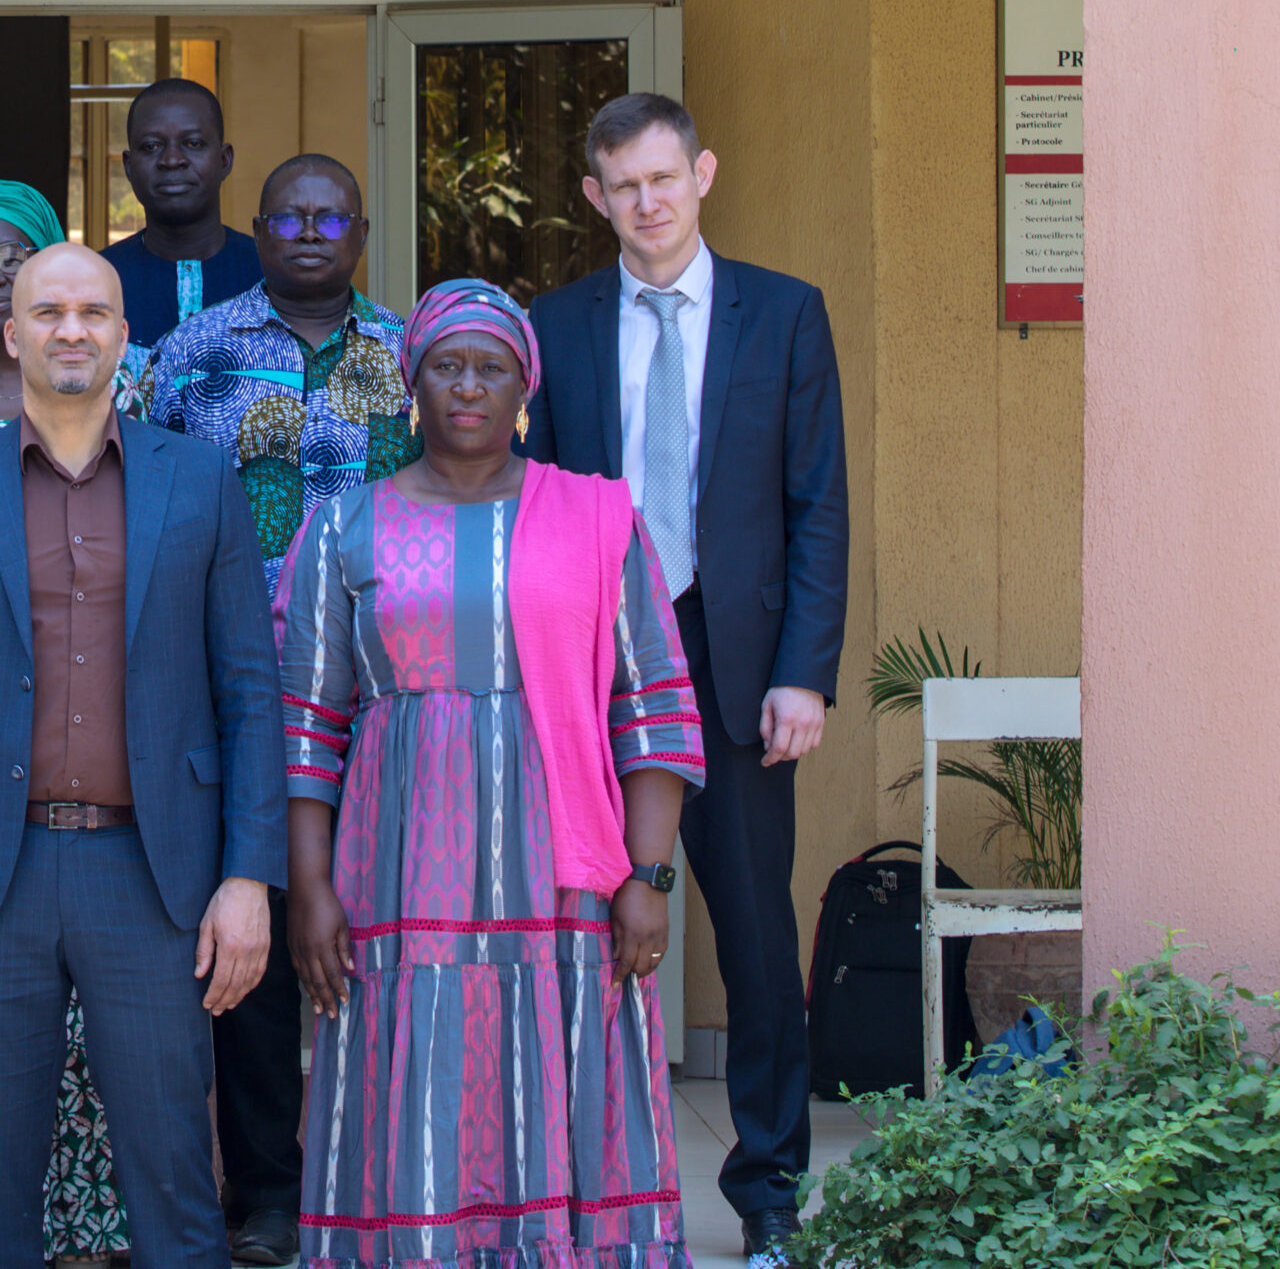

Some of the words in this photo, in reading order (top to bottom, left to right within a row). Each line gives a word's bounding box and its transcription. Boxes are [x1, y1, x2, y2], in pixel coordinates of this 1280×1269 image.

[1020, 111, 1068, 119] Secrétariat
[1015, 120, 1063, 130] particulier
[1021, 137, 1063, 146] Protocole
[1024, 180, 1069, 189] Secrétaire
[1025, 198, 1038, 206] SG
[1040, 198, 1072, 207] Adjoint
[1025, 215, 1073, 223] Secrétariat
[1025, 232, 1074, 240] Conseillers
[1025, 265, 1046, 273] Chef
[1047, 265, 1058, 273] de
